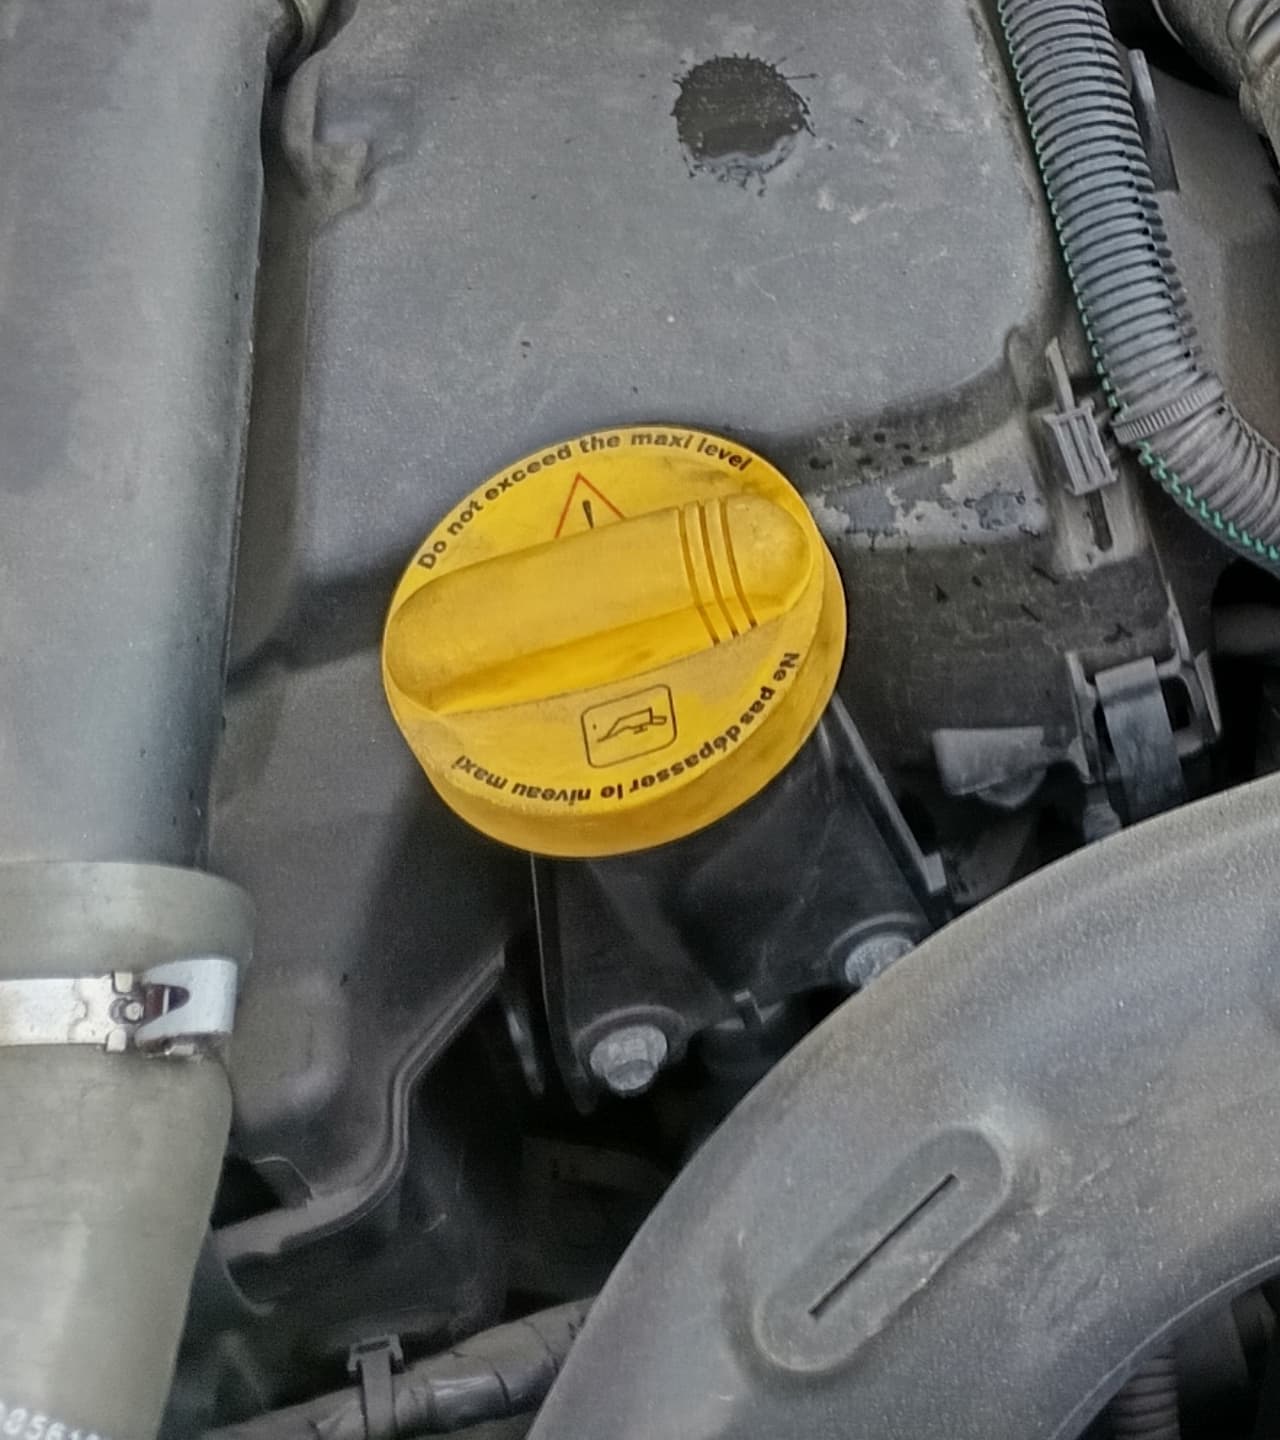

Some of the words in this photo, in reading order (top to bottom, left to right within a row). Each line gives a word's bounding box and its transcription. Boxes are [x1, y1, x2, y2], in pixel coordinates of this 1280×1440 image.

[417, 540, 447, 570] Do
[447, 500, 484, 536] not
[484, 444, 572, 501] exceed
[579, 435, 620, 453] the
[631, 433, 694, 449] maxi
[697, 438, 752, 471] level
[773, 652, 800, 681] Ne
[740, 686, 775, 725] pas
[451, 755, 508, 789] maxi
[629, 725, 741, 793] dépasser
[511, 783, 591, 806] niveau
[600, 783, 623, 800] le
